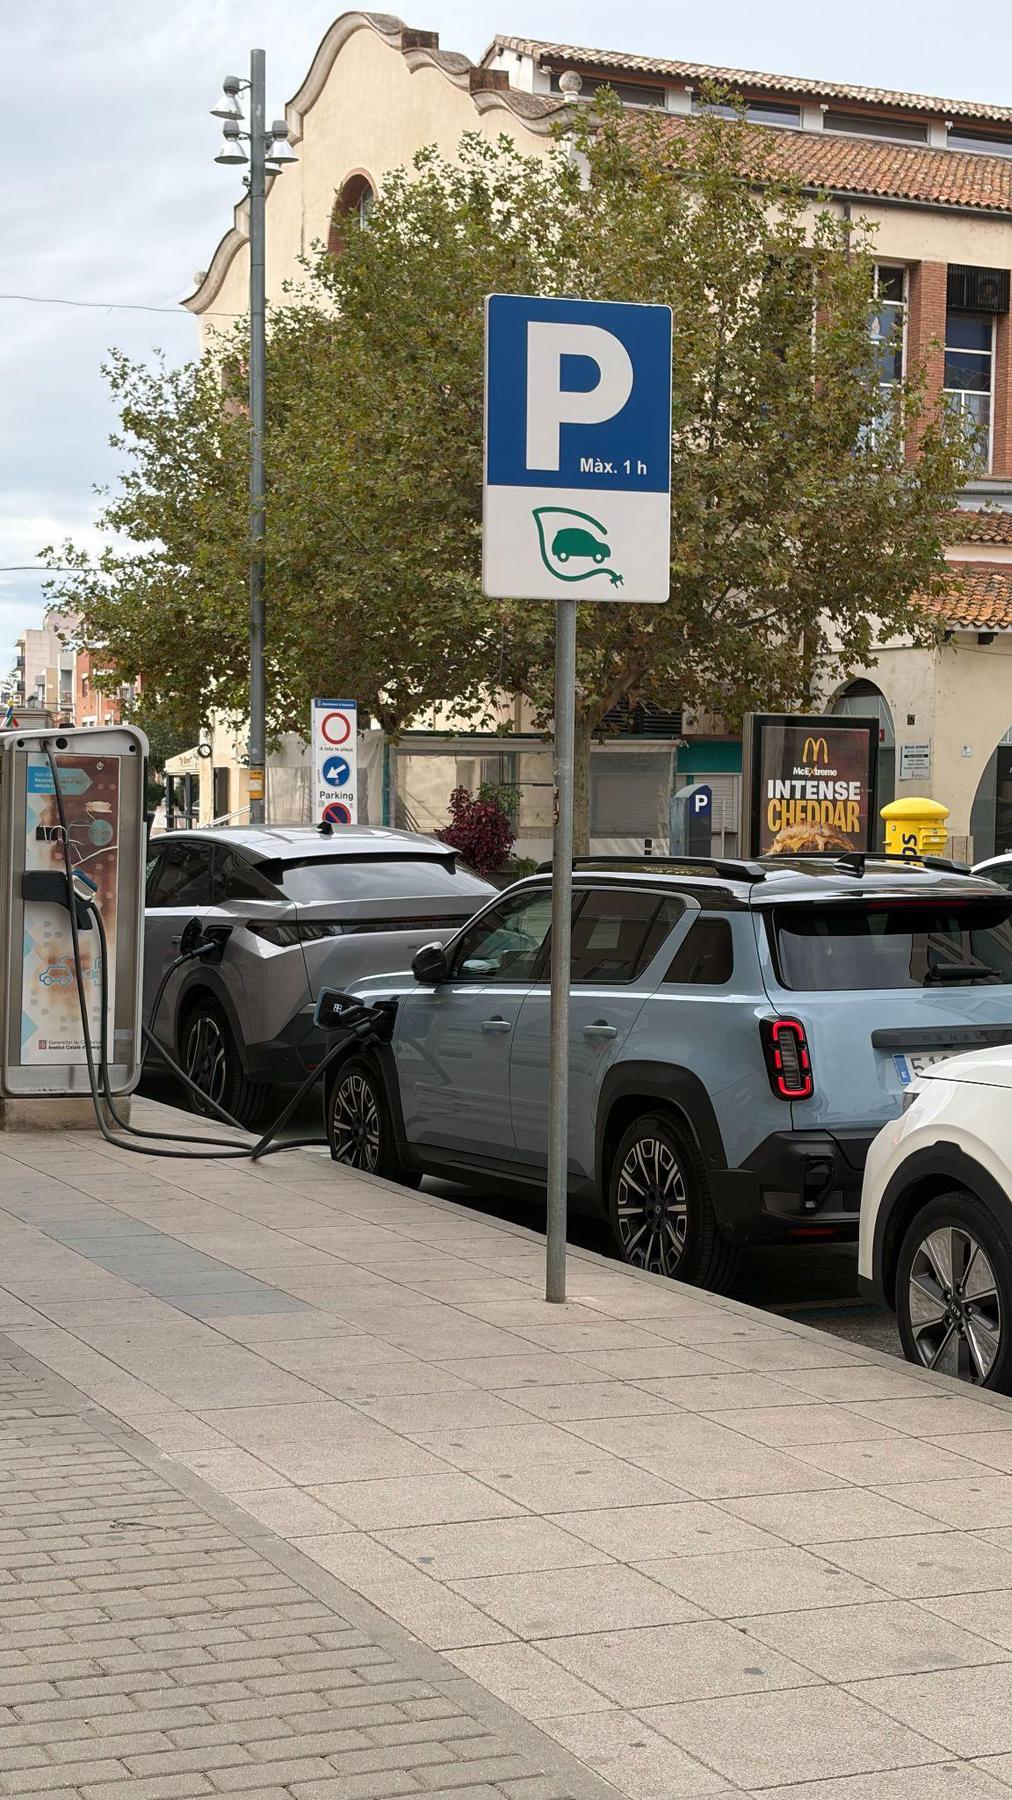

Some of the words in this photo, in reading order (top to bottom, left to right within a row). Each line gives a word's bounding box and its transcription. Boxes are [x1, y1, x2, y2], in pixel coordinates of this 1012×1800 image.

[526, 321, 634, 471] P
[580, 457, 617, 475] Màx.
[623, 460, 631, 475] 1
[637, 460, 648, 476] h
[319, 790, 354, 801] Parking
[767, 779, 861, 800] INTENSE
[695, 794, 708, 813] P
[767, 799, 861, 833] CHEDDAR
